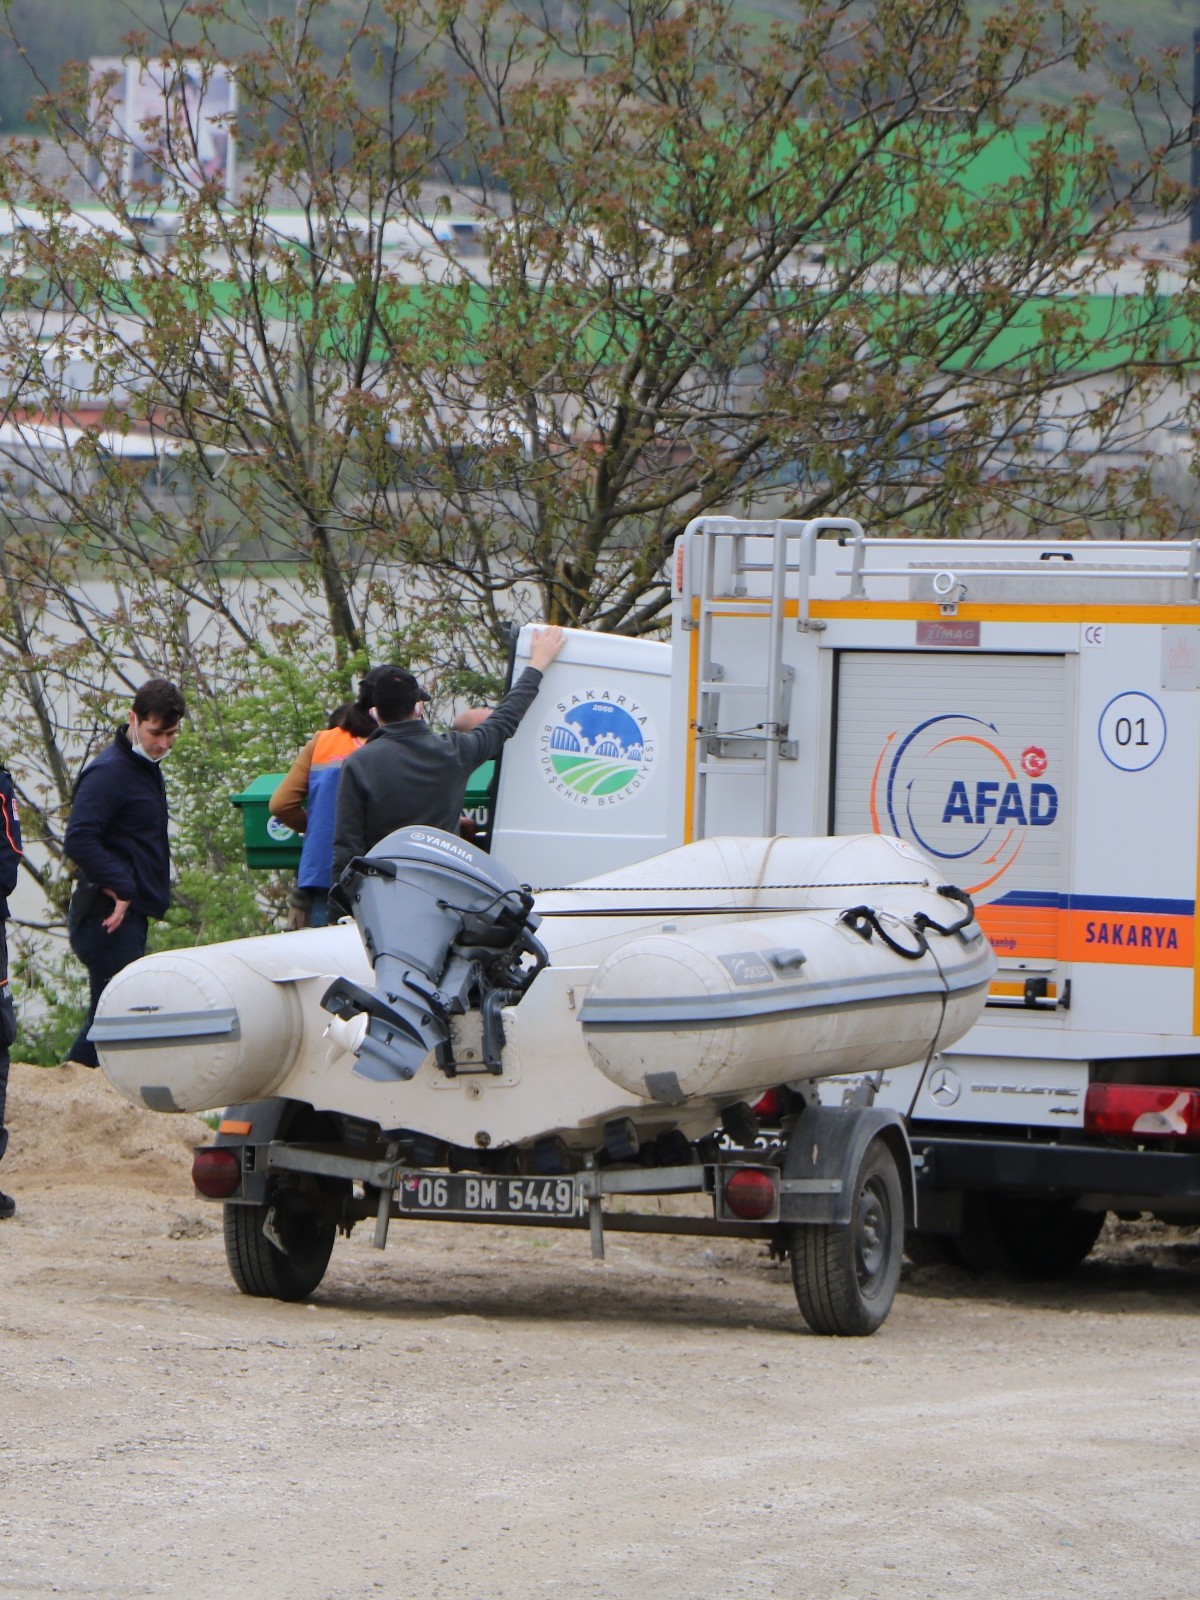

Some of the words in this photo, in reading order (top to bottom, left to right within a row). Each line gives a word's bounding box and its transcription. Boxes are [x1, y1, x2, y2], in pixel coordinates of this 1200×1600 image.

[1085, 626, 1102, 644] CE
[556, 689, 648, 726] SAKARYA
[592, 704, 613, 713] 2000
[1115, 717, 1149, 746] 01
[942, 780, 1059, 826] AFAD
[427, 835, 473, 862] YAMAHA
[1086, 921, 1178, 949] SAKARYA
[1001, 1085, 1080, 1097] BLUETEC
[417, 1178, 448, 1208] 06
[465, 1179, 497, 1209] BM
[508, 1181, 571, 1212] 5449
